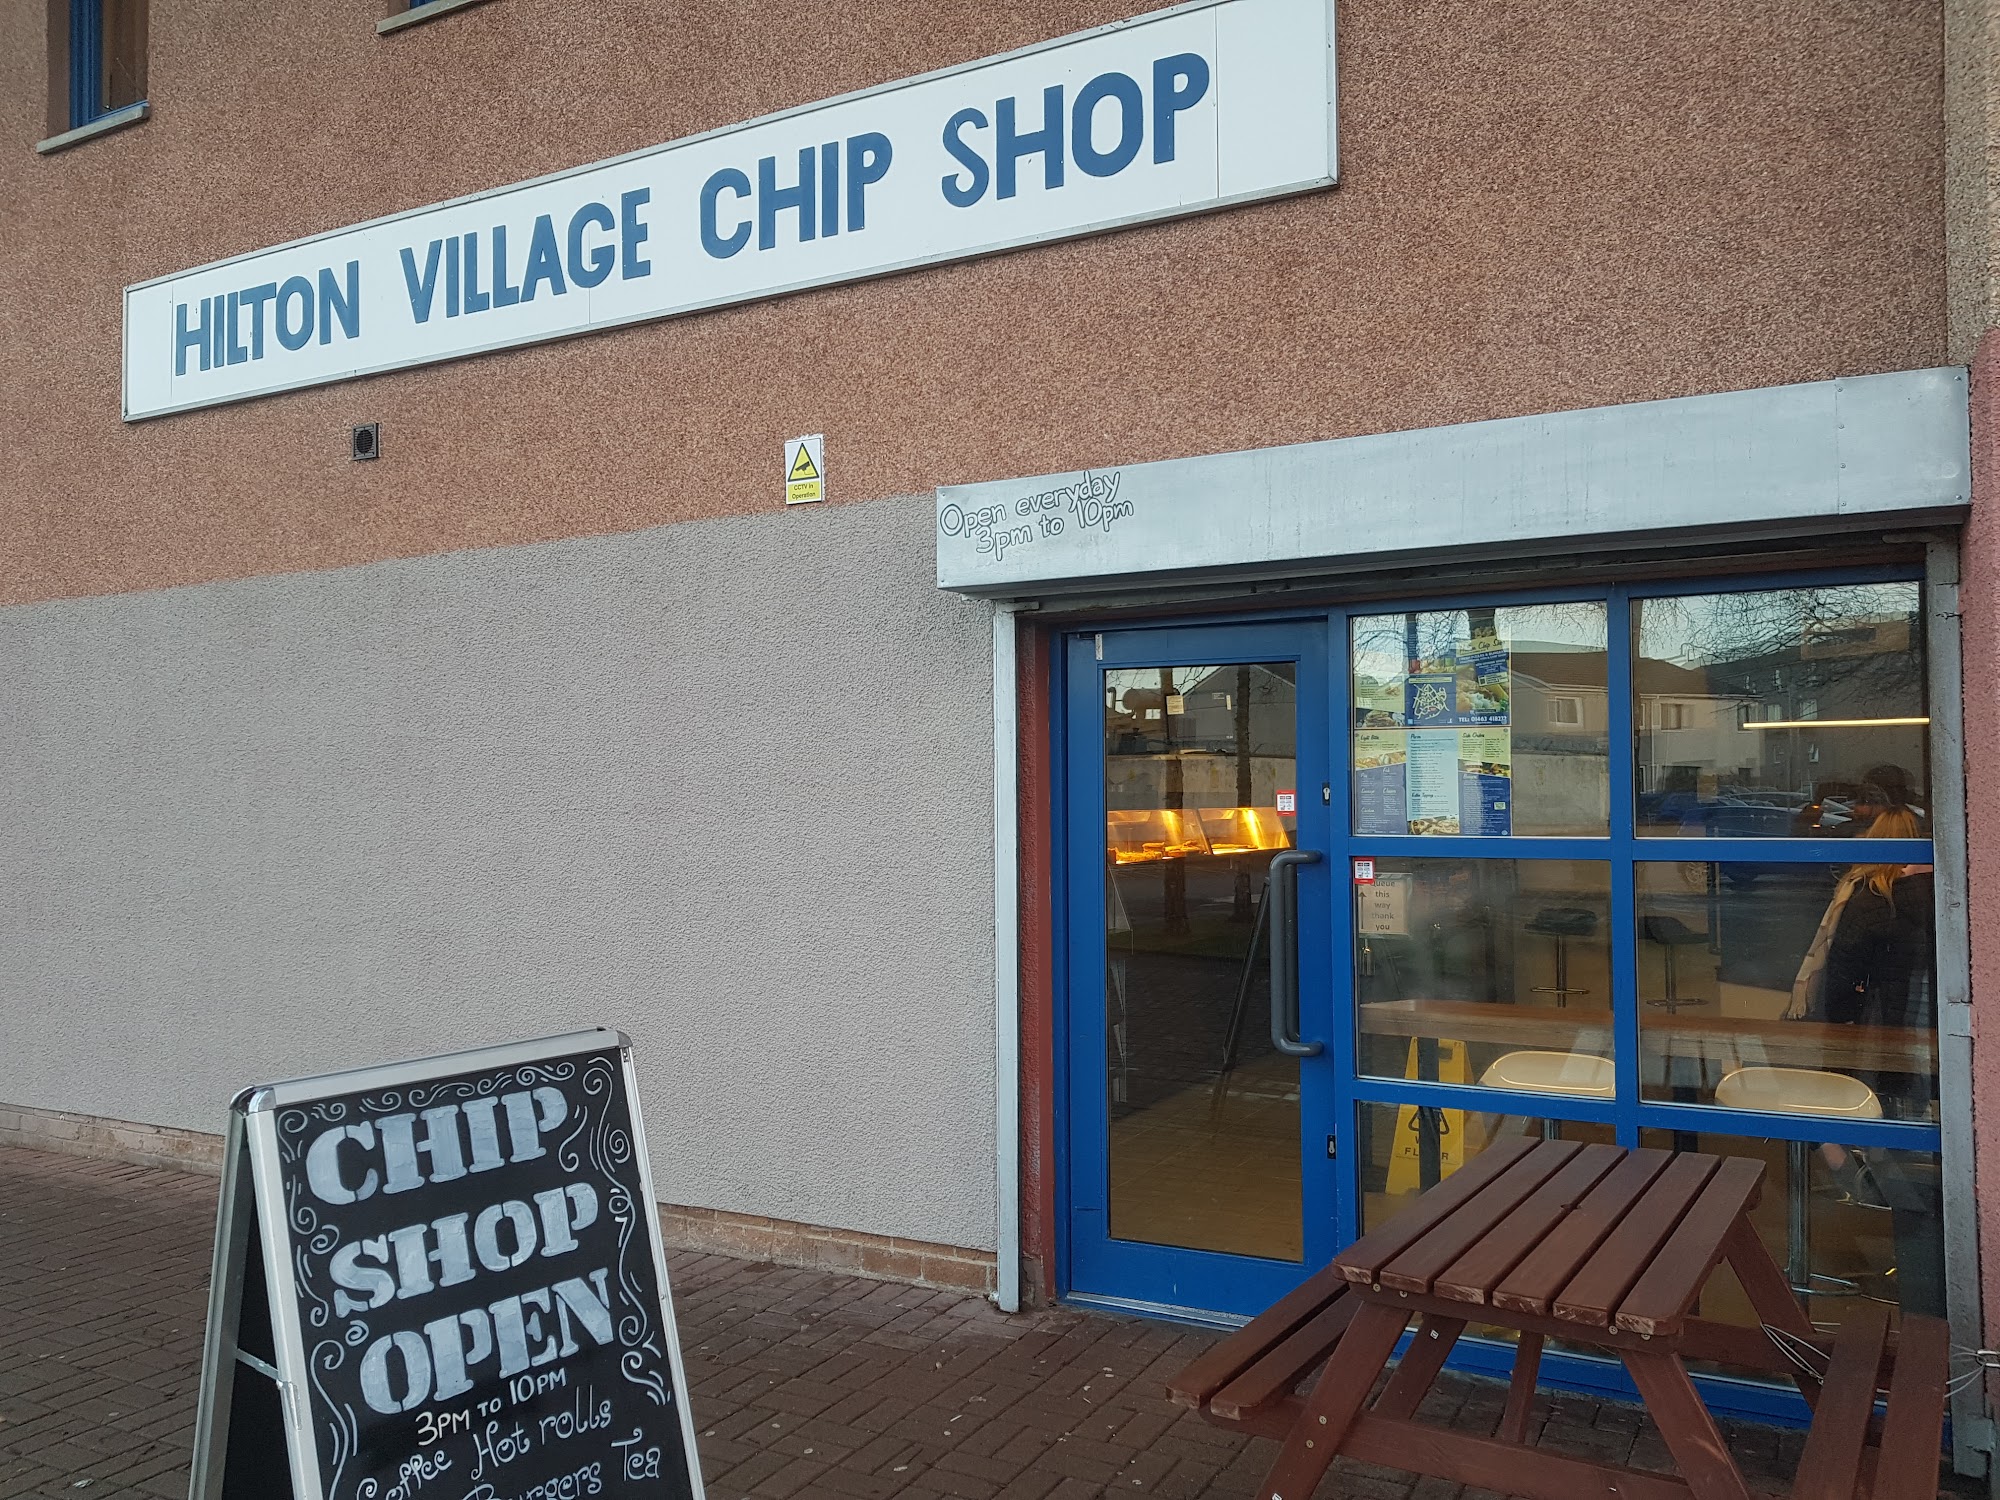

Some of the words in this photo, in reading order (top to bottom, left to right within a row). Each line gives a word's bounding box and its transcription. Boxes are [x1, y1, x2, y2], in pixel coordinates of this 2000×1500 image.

[174, 261, 360, 376] HILTON
[400, 187, 651, 324] VILLAGE
[700, 131, 893, 259] CHIP
[941, 52, 1210, 208] SHOP
[791, 491, 816, 500] Operation
[793, 483, 808, 491] CCTV
[940, 503, 1007, 538] Open
[1015, 470, 1121, 516] everyday
[975, 525, 1033, 561] 3pm
[1039, 513, 1064, 537] to
[1076, 498, 1134, 532] 10pm
[1371, 911, 1395, 919] thank
[1375, 890, 1390, 898] this
[305, 1086, 568, 1206] CHIP
[1404, 1147, 1449, 1161] FLR
[328, 1182, 598, 1319] SHOP
[359, 1267, 615, 1415] OPEN
[414, 1409, 471, 1446] 3PM
[509, 1367, 567, 1405] 10PM
[471, 1420, 530, 1481] Hot
[538, 1385, 612, 1445] rolls
[610, 1428, 662, 1482] Tea
